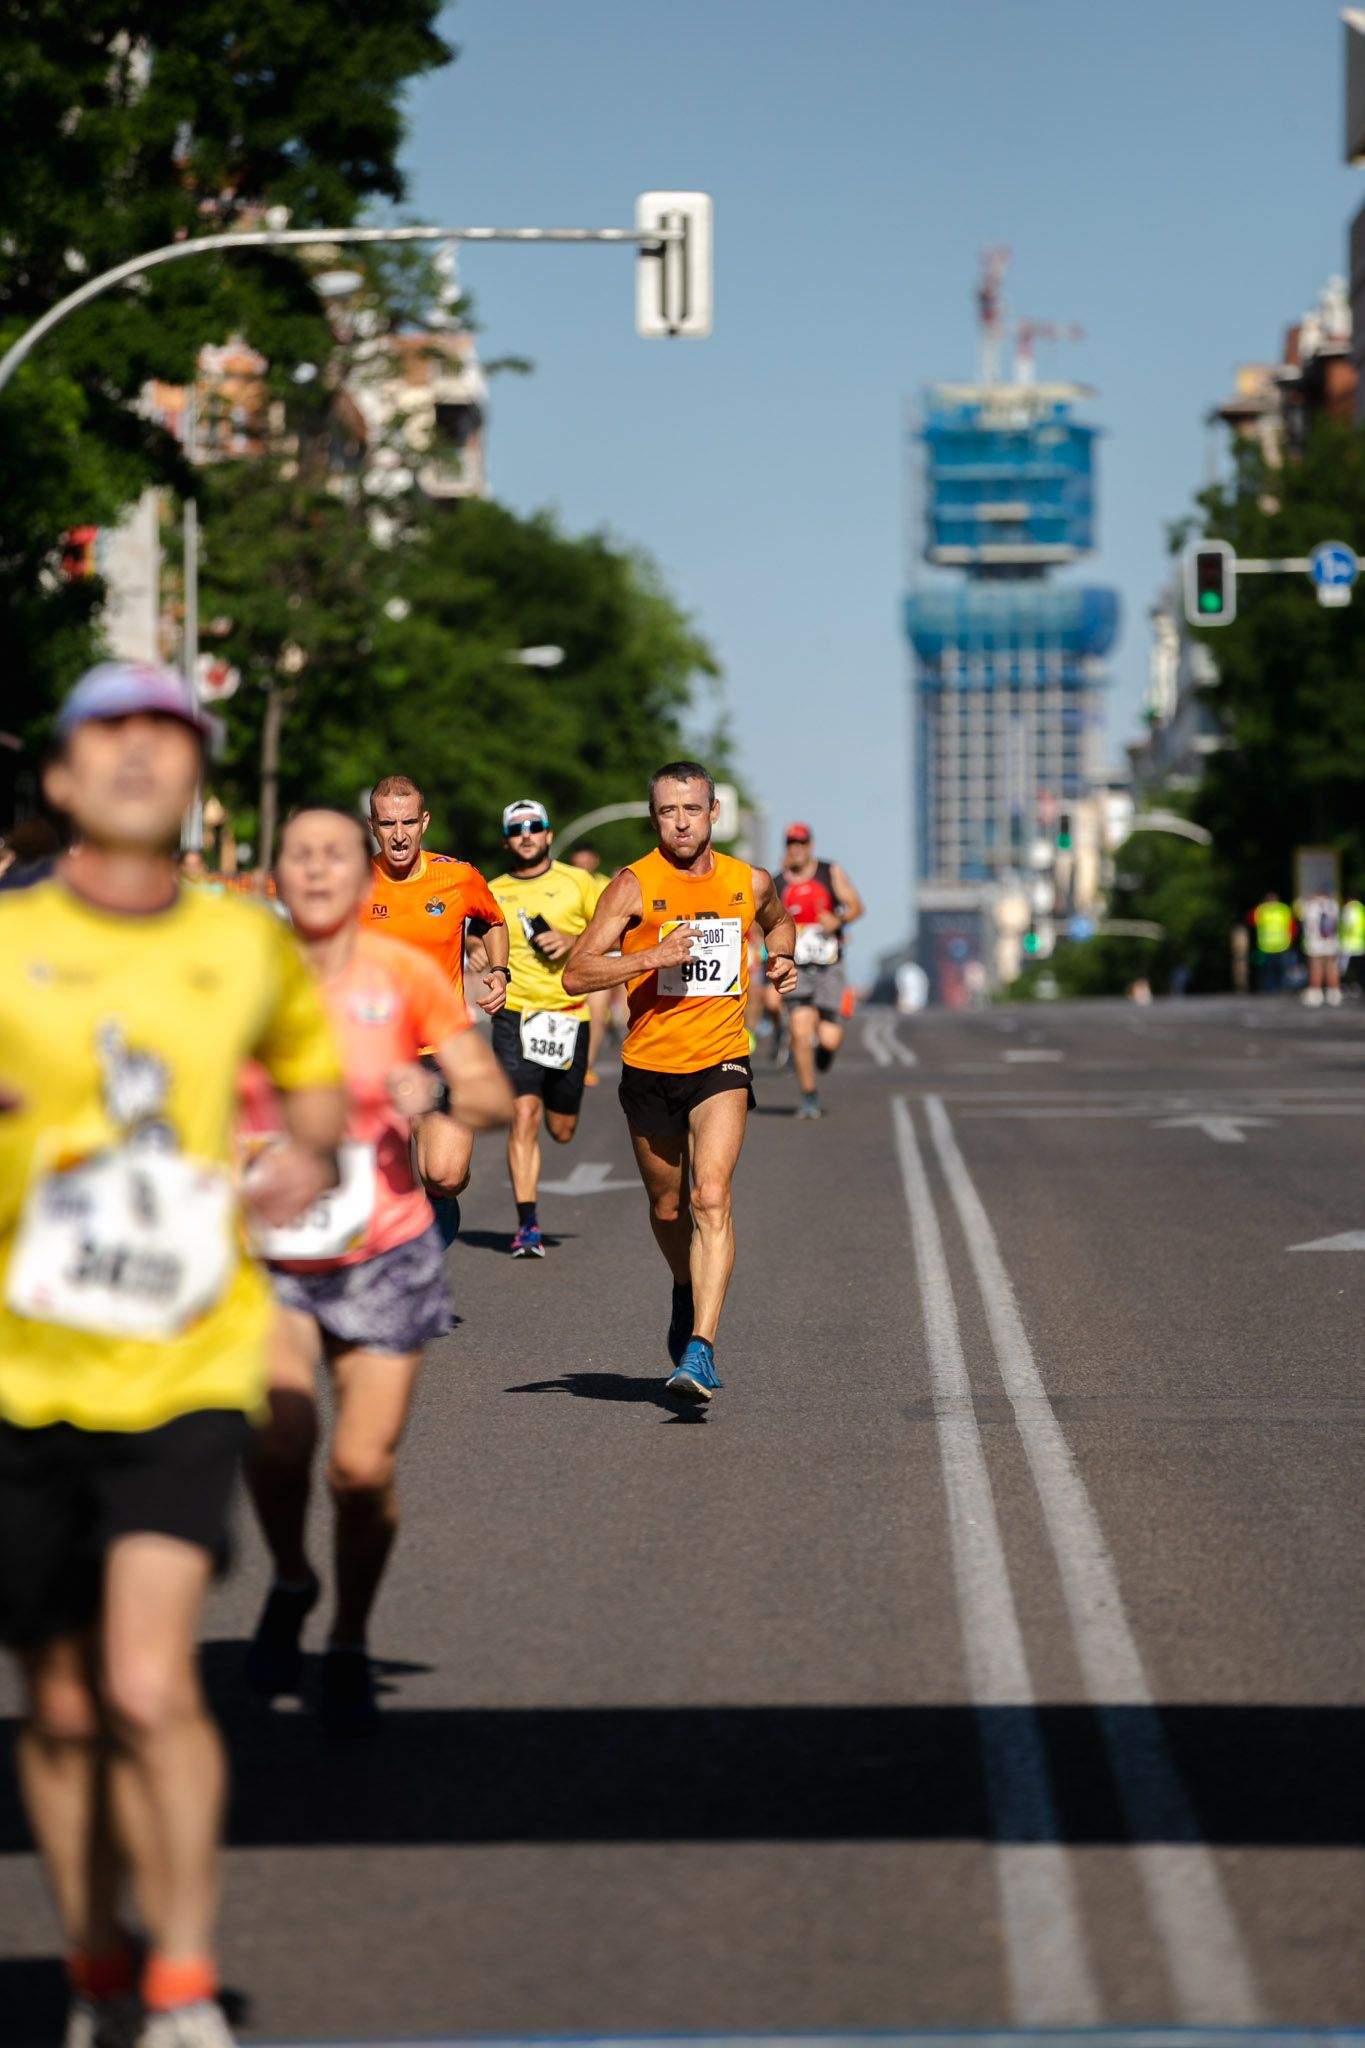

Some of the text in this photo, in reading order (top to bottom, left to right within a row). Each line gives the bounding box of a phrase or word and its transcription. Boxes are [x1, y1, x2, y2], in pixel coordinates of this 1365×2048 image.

[703, 928, 724, 944] 5087
[681, 960, 721, 982] 962
[530, 1038, 564, 1057] 3384
